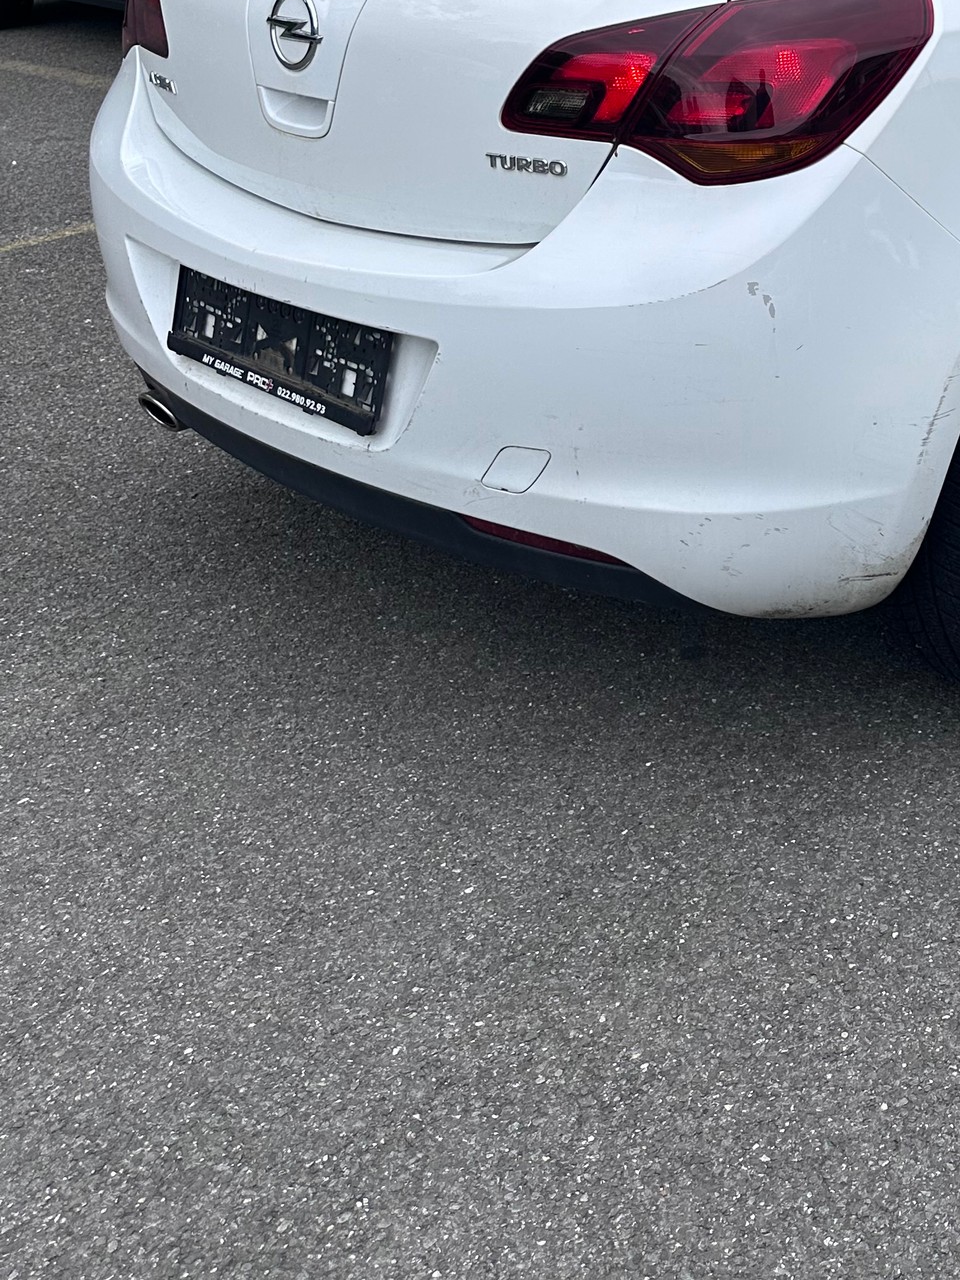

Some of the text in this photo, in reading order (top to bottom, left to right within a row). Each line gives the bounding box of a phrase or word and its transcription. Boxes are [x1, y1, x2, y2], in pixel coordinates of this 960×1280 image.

[485, 152, 568, 177] TURBO
[202, 353, 214, 365] MY
[214, 359, 244, 379] GARAGE
[276, 386, 326, 414] 022.980.92.93
